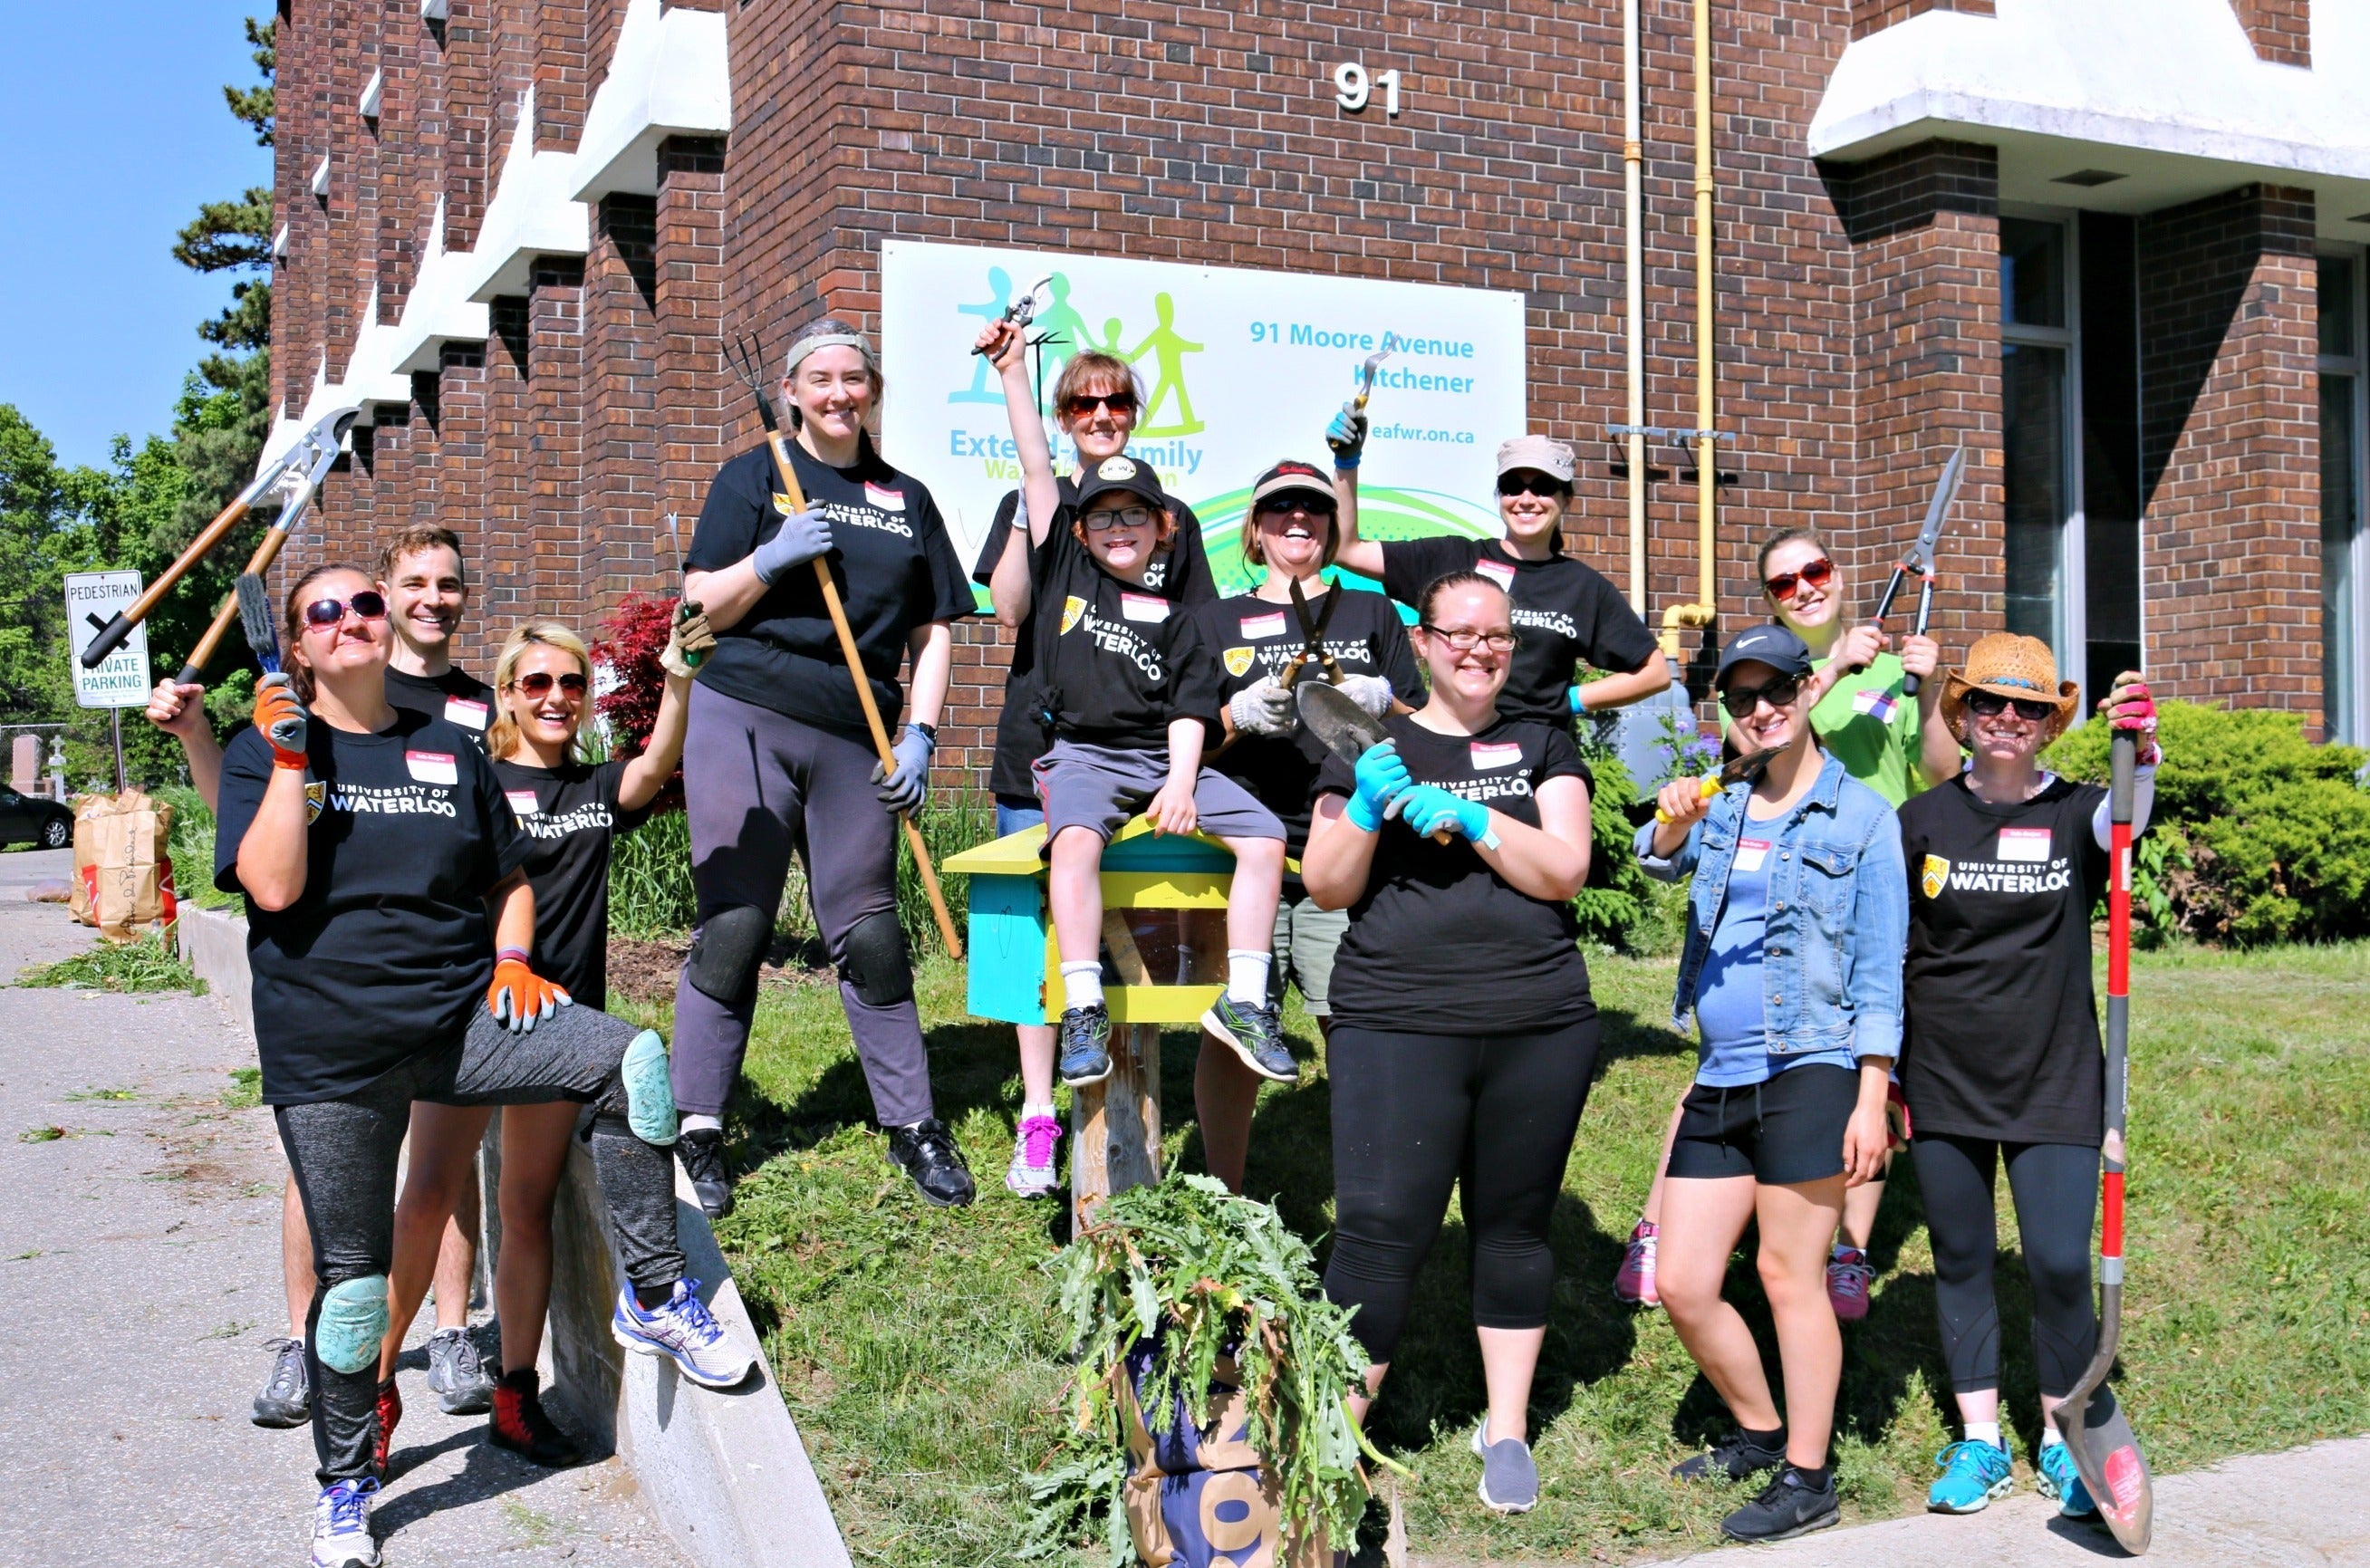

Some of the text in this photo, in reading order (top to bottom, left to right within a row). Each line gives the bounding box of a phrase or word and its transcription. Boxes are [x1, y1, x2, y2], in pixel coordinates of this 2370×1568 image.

[1334, 61, 1401, 116] 91
[1249, 321, 1475, 359] 91 Moore Avenue
[1372, 422, 1475, 445] eafwr.on.ca
[824, 502, 885, 519] IVERSITY
[824, 509, 914, 538] ATERLOO
[70, 583, 139, 600] PEDESTRIAN
[1510, 615, 1578, 640] TERLOO
[1084, 614, 1161, 681] WTERLOO
[1263, 639, 1368, 652] UNIVEITY OF
[82, 674, 142, 690] PARKING
[337, 784, 449, 799] UNIVERSITY OF
[1451, 777, 1535, 802] TERLO
[330, 793, 458, 818] WATERLOO
[525, 811, 614, 839] WATERLO
